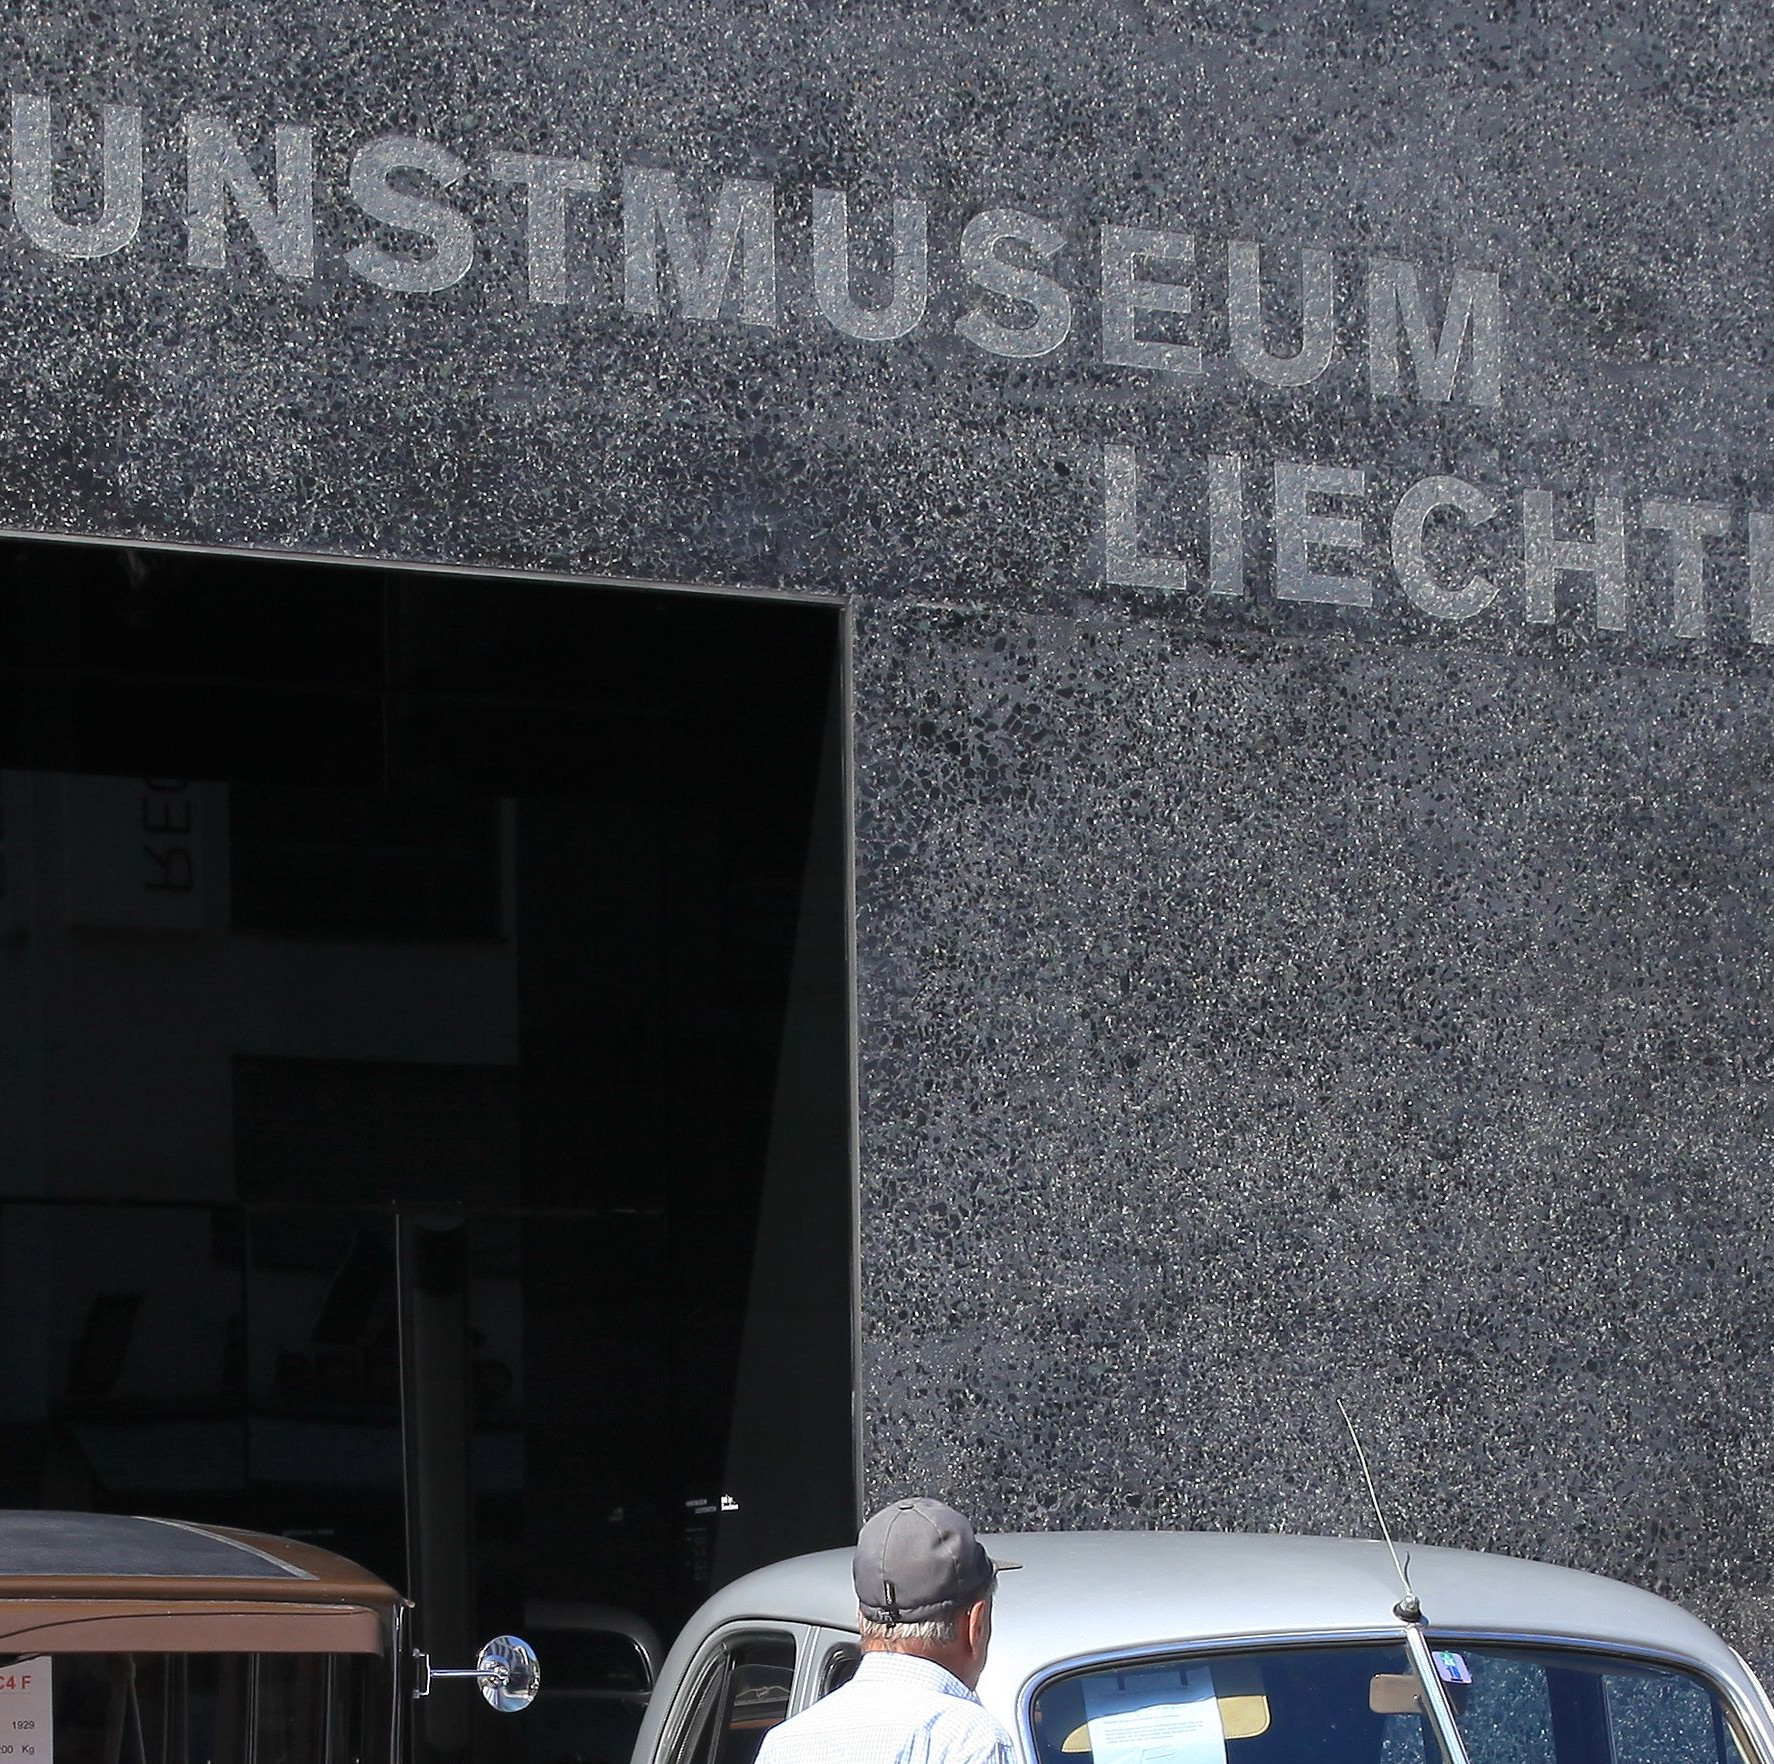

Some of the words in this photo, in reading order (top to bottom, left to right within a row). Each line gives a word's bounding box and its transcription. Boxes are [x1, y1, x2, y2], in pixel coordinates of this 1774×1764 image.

[21, 1675, 32, 1690] F
[12, 1720, 35, 1730] 1929
[21, 1744, 35, 1756] Kg
